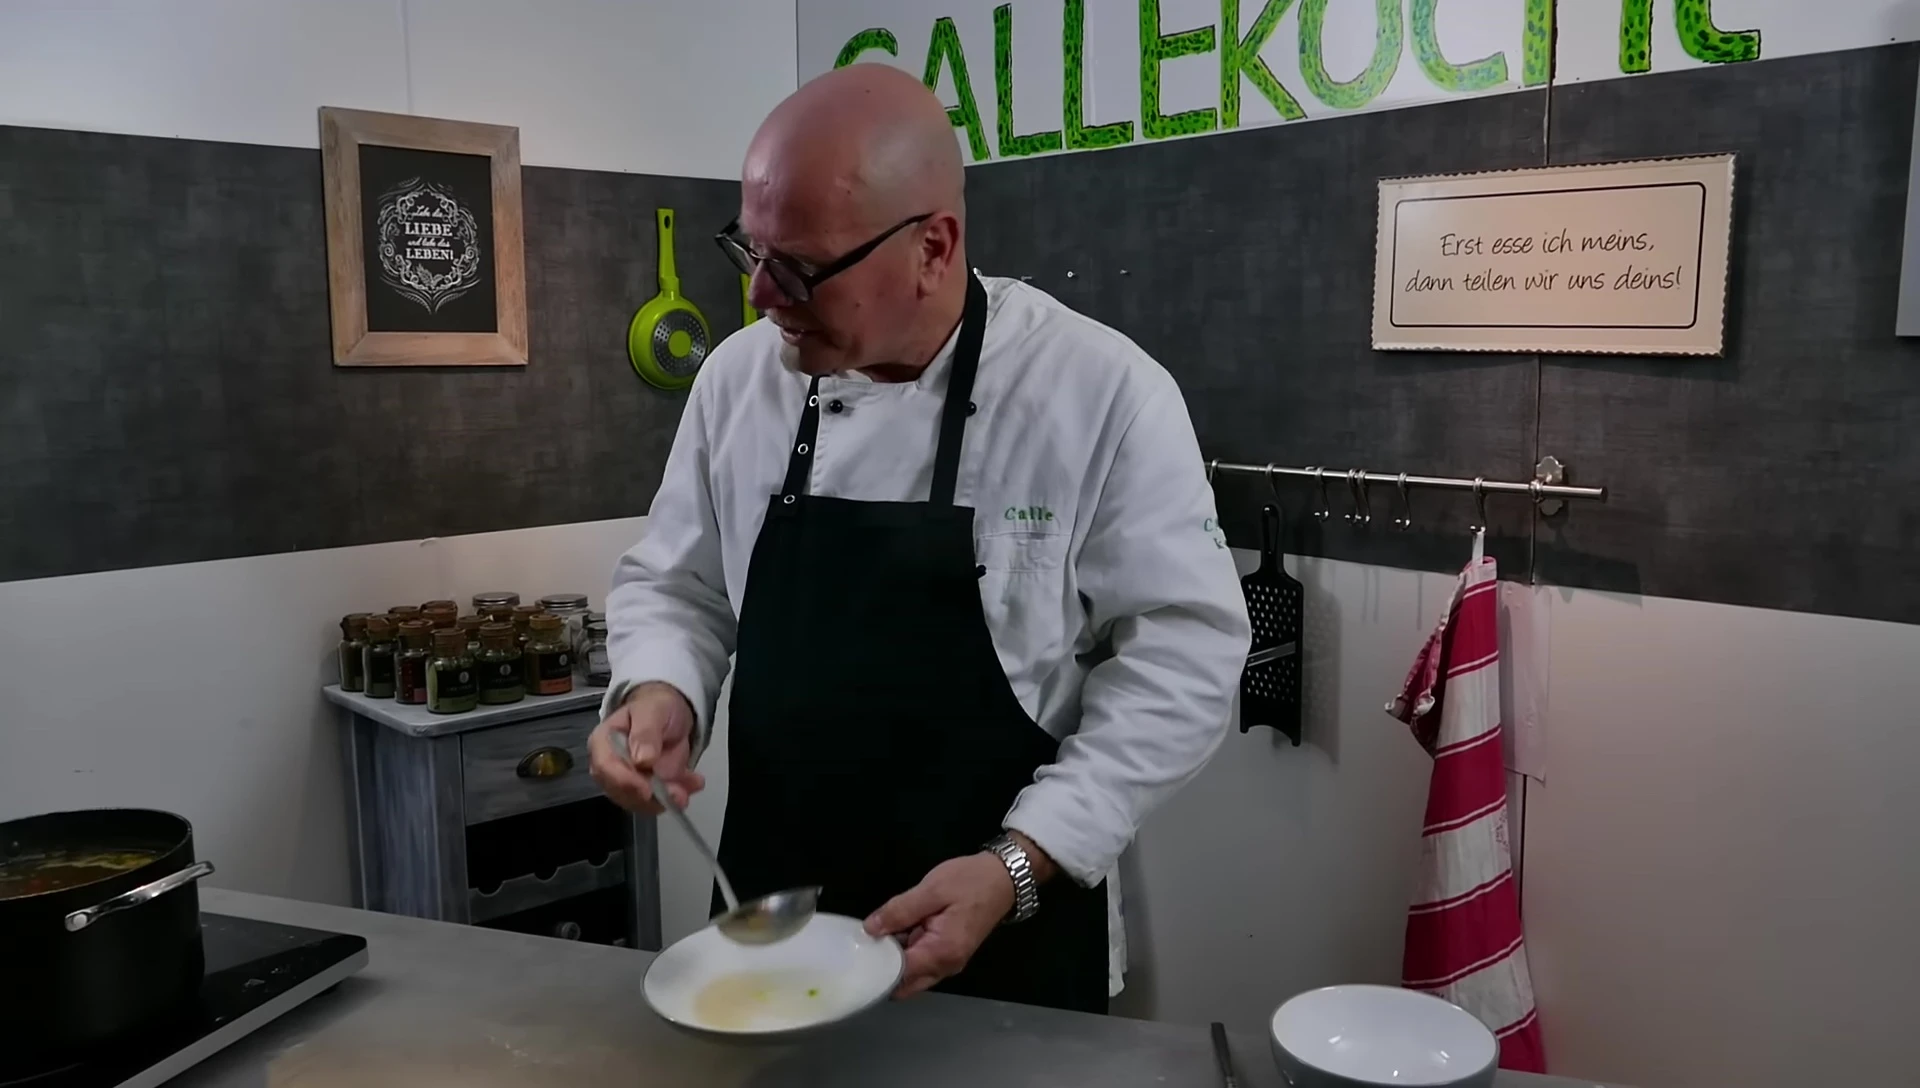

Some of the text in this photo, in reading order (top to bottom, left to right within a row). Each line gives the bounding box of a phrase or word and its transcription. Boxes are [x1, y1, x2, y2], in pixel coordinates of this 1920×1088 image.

[405, 222, 453, 236] LIEBE
[1440, 228, 1656, 257] Erst esse ich meins,
[406, 248, 454, 260] LEBEN!
[1405, 265, 1683, 293] dann teilen wir uns deins!
[1004, 506, 1054, 521] Calle
